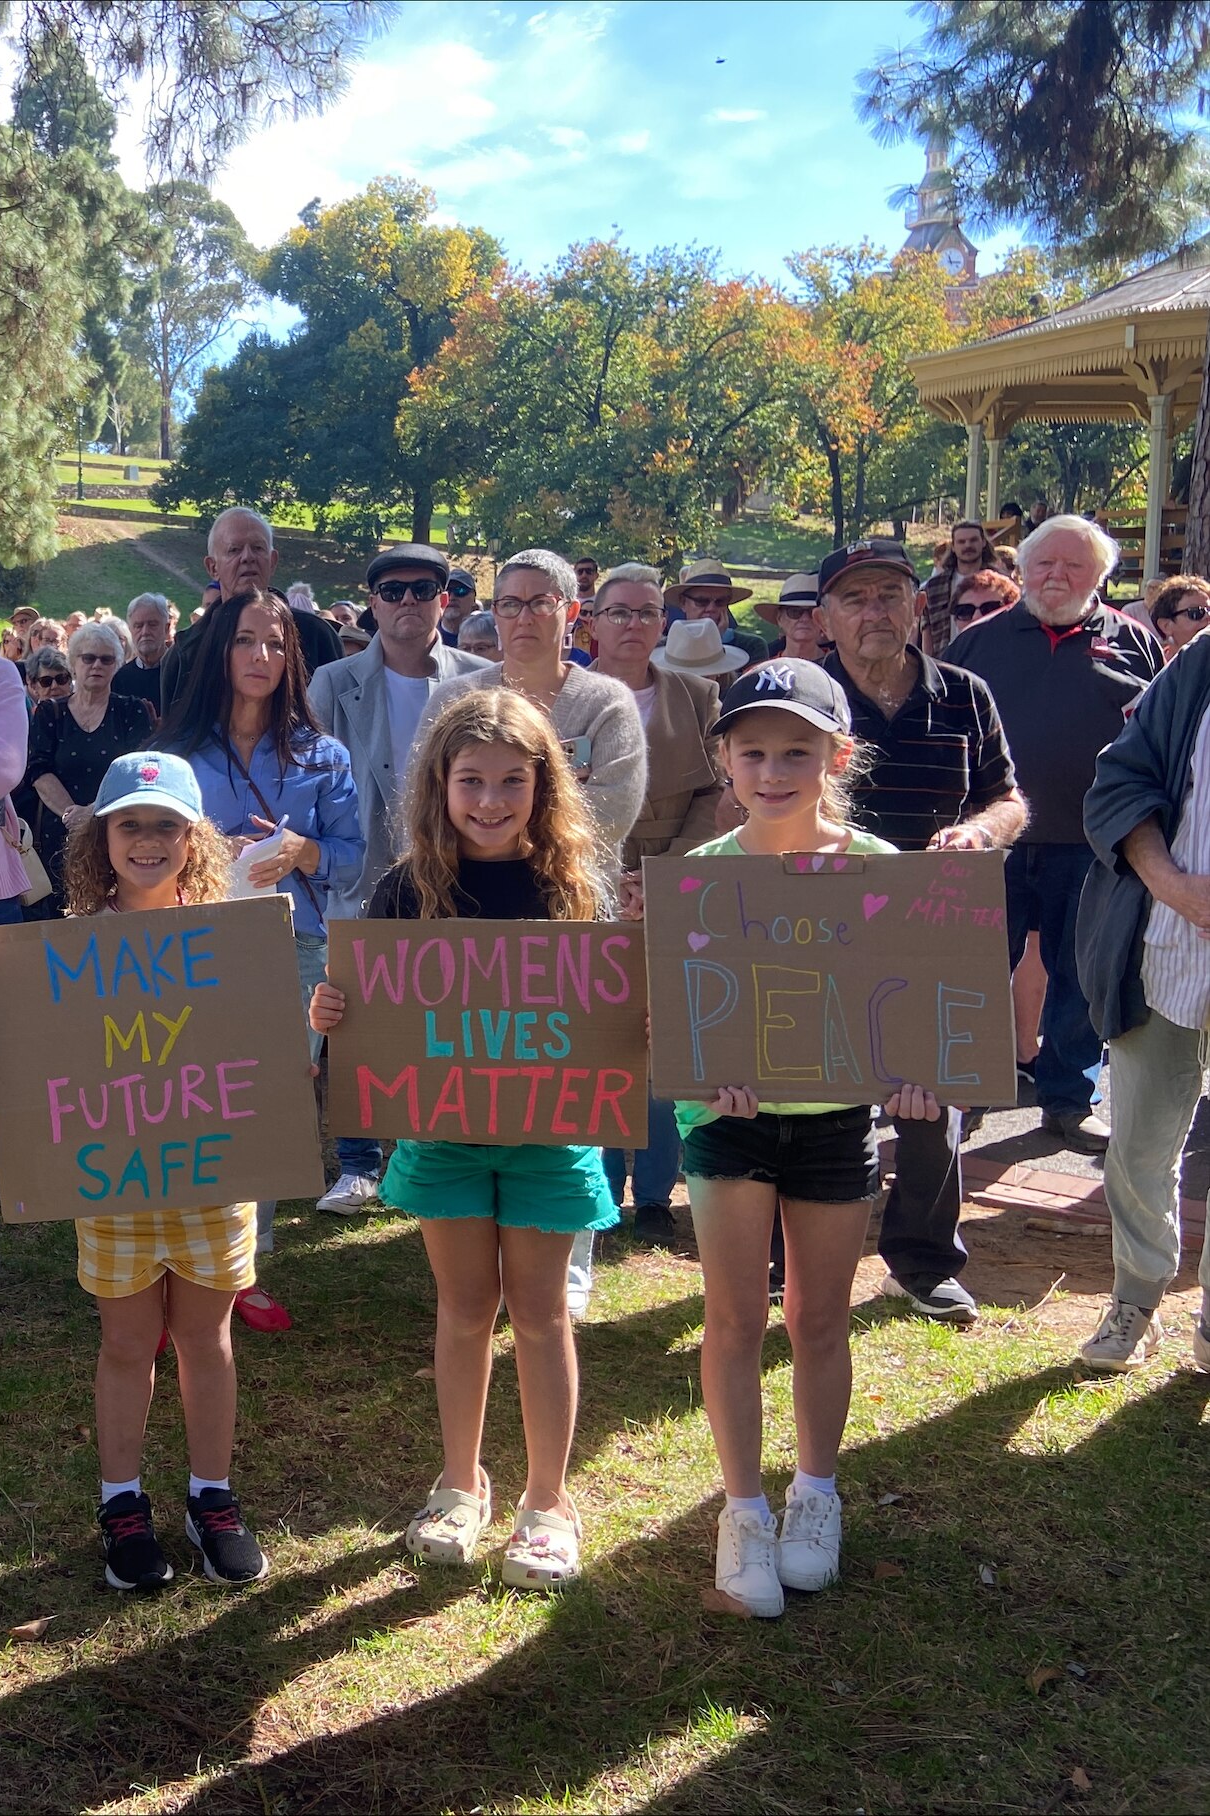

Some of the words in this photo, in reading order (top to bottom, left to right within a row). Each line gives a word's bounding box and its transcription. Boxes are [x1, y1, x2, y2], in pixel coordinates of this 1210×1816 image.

[755, 664, 795, 692] NY
[699, 881, 853, 946] Choose
[905, 897, 1004, 933] MATTER
[44, 927, 220, 1005] MAKE
[352, 933, 631, 1014] WOMENS
[103, 1005, 193, 1068] MY
[424, 1009, 572, 1060] LIVES
[683, 959, 986, 1085] PEACE
[47, 1059, 260, 1144] FUTURE
[355, 1064, 634, 1137] MATTER
[76, 1133, 233, 1201] SAFE
